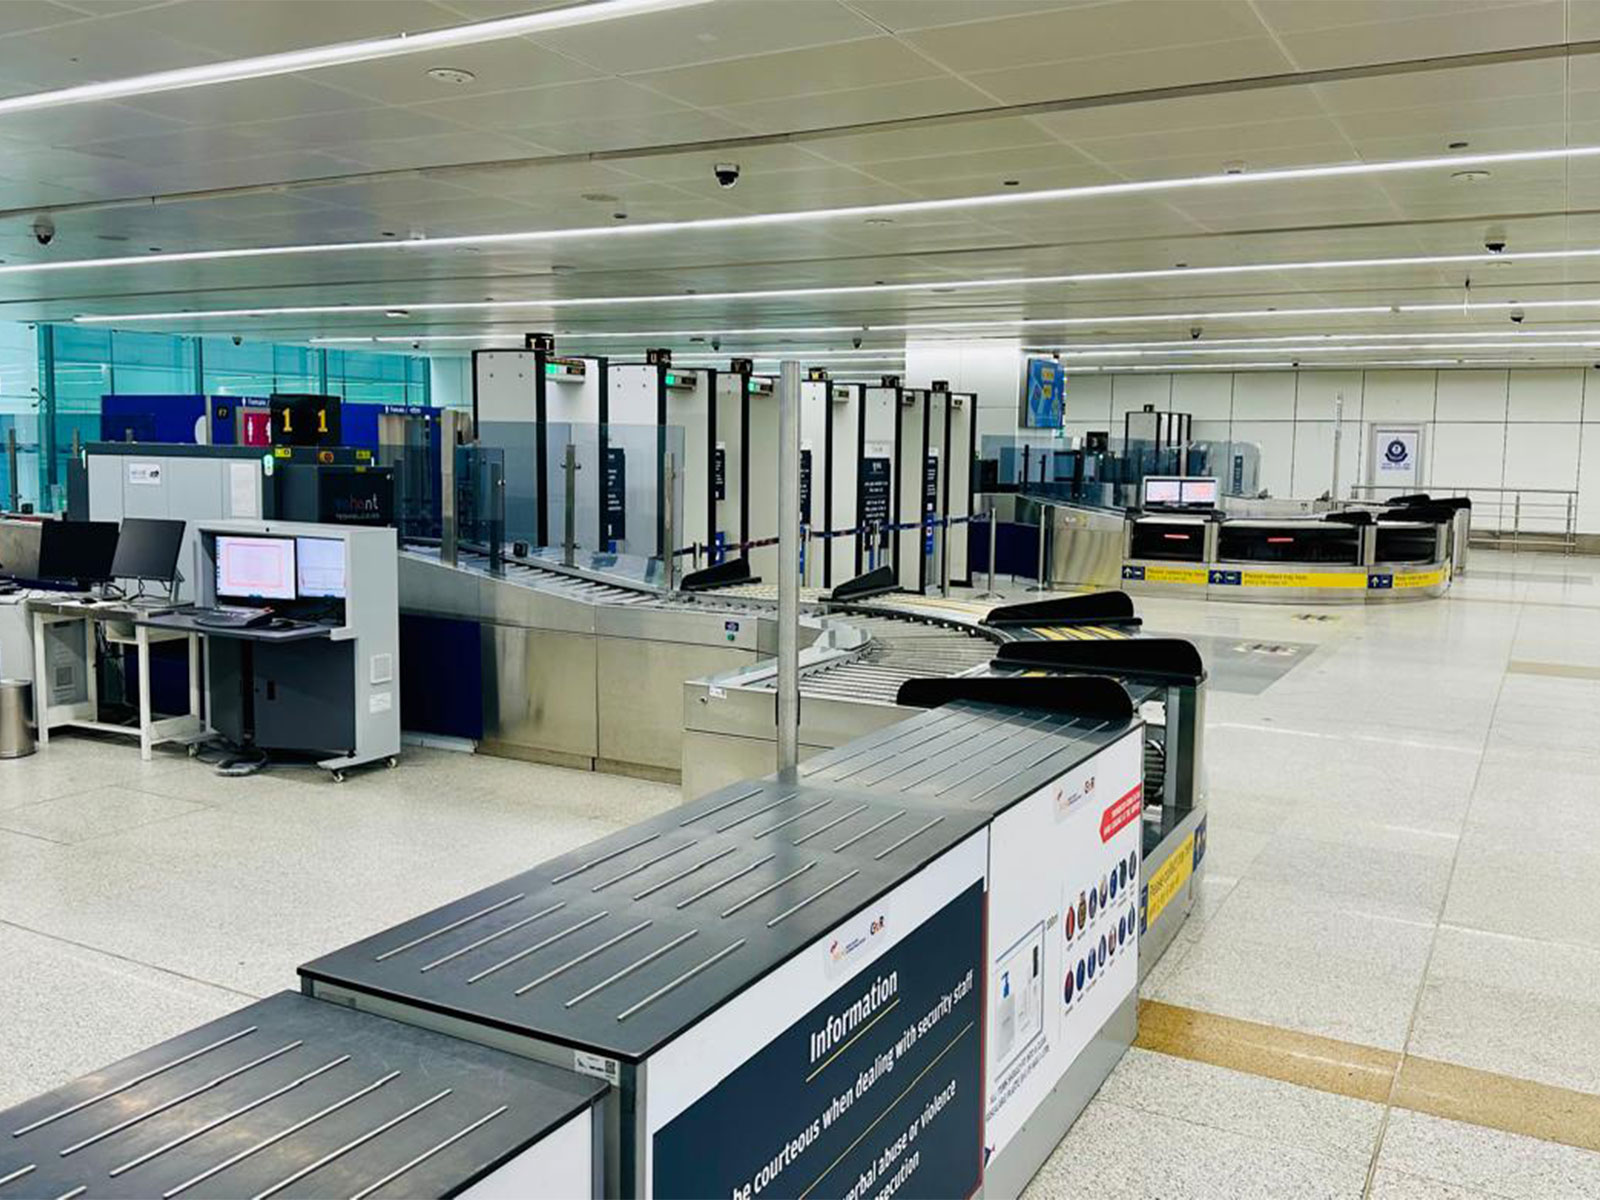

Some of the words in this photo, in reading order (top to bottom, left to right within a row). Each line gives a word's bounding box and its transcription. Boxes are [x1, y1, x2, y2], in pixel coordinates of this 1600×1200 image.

[282, 407, 293, 432] 1
[316, 409, 328, 433] 1
[809, 970, 898, 1063] Information
[753, 1118, 820, 1195] courteous
[822, 1087, 853, 1129] when
[855, 1046, 894, 1099] dealing
[895, 1026, 917, 1060] with
[917, 992, 953, 1039] security
[953, 968, 974, 1005] staff
[842, 1159, 877, 1200] verbal
[877, 1132, 908, 1176] abuse
[908, 1118, 920, 1143] or
[920, 1079, 957, 1129] violence
